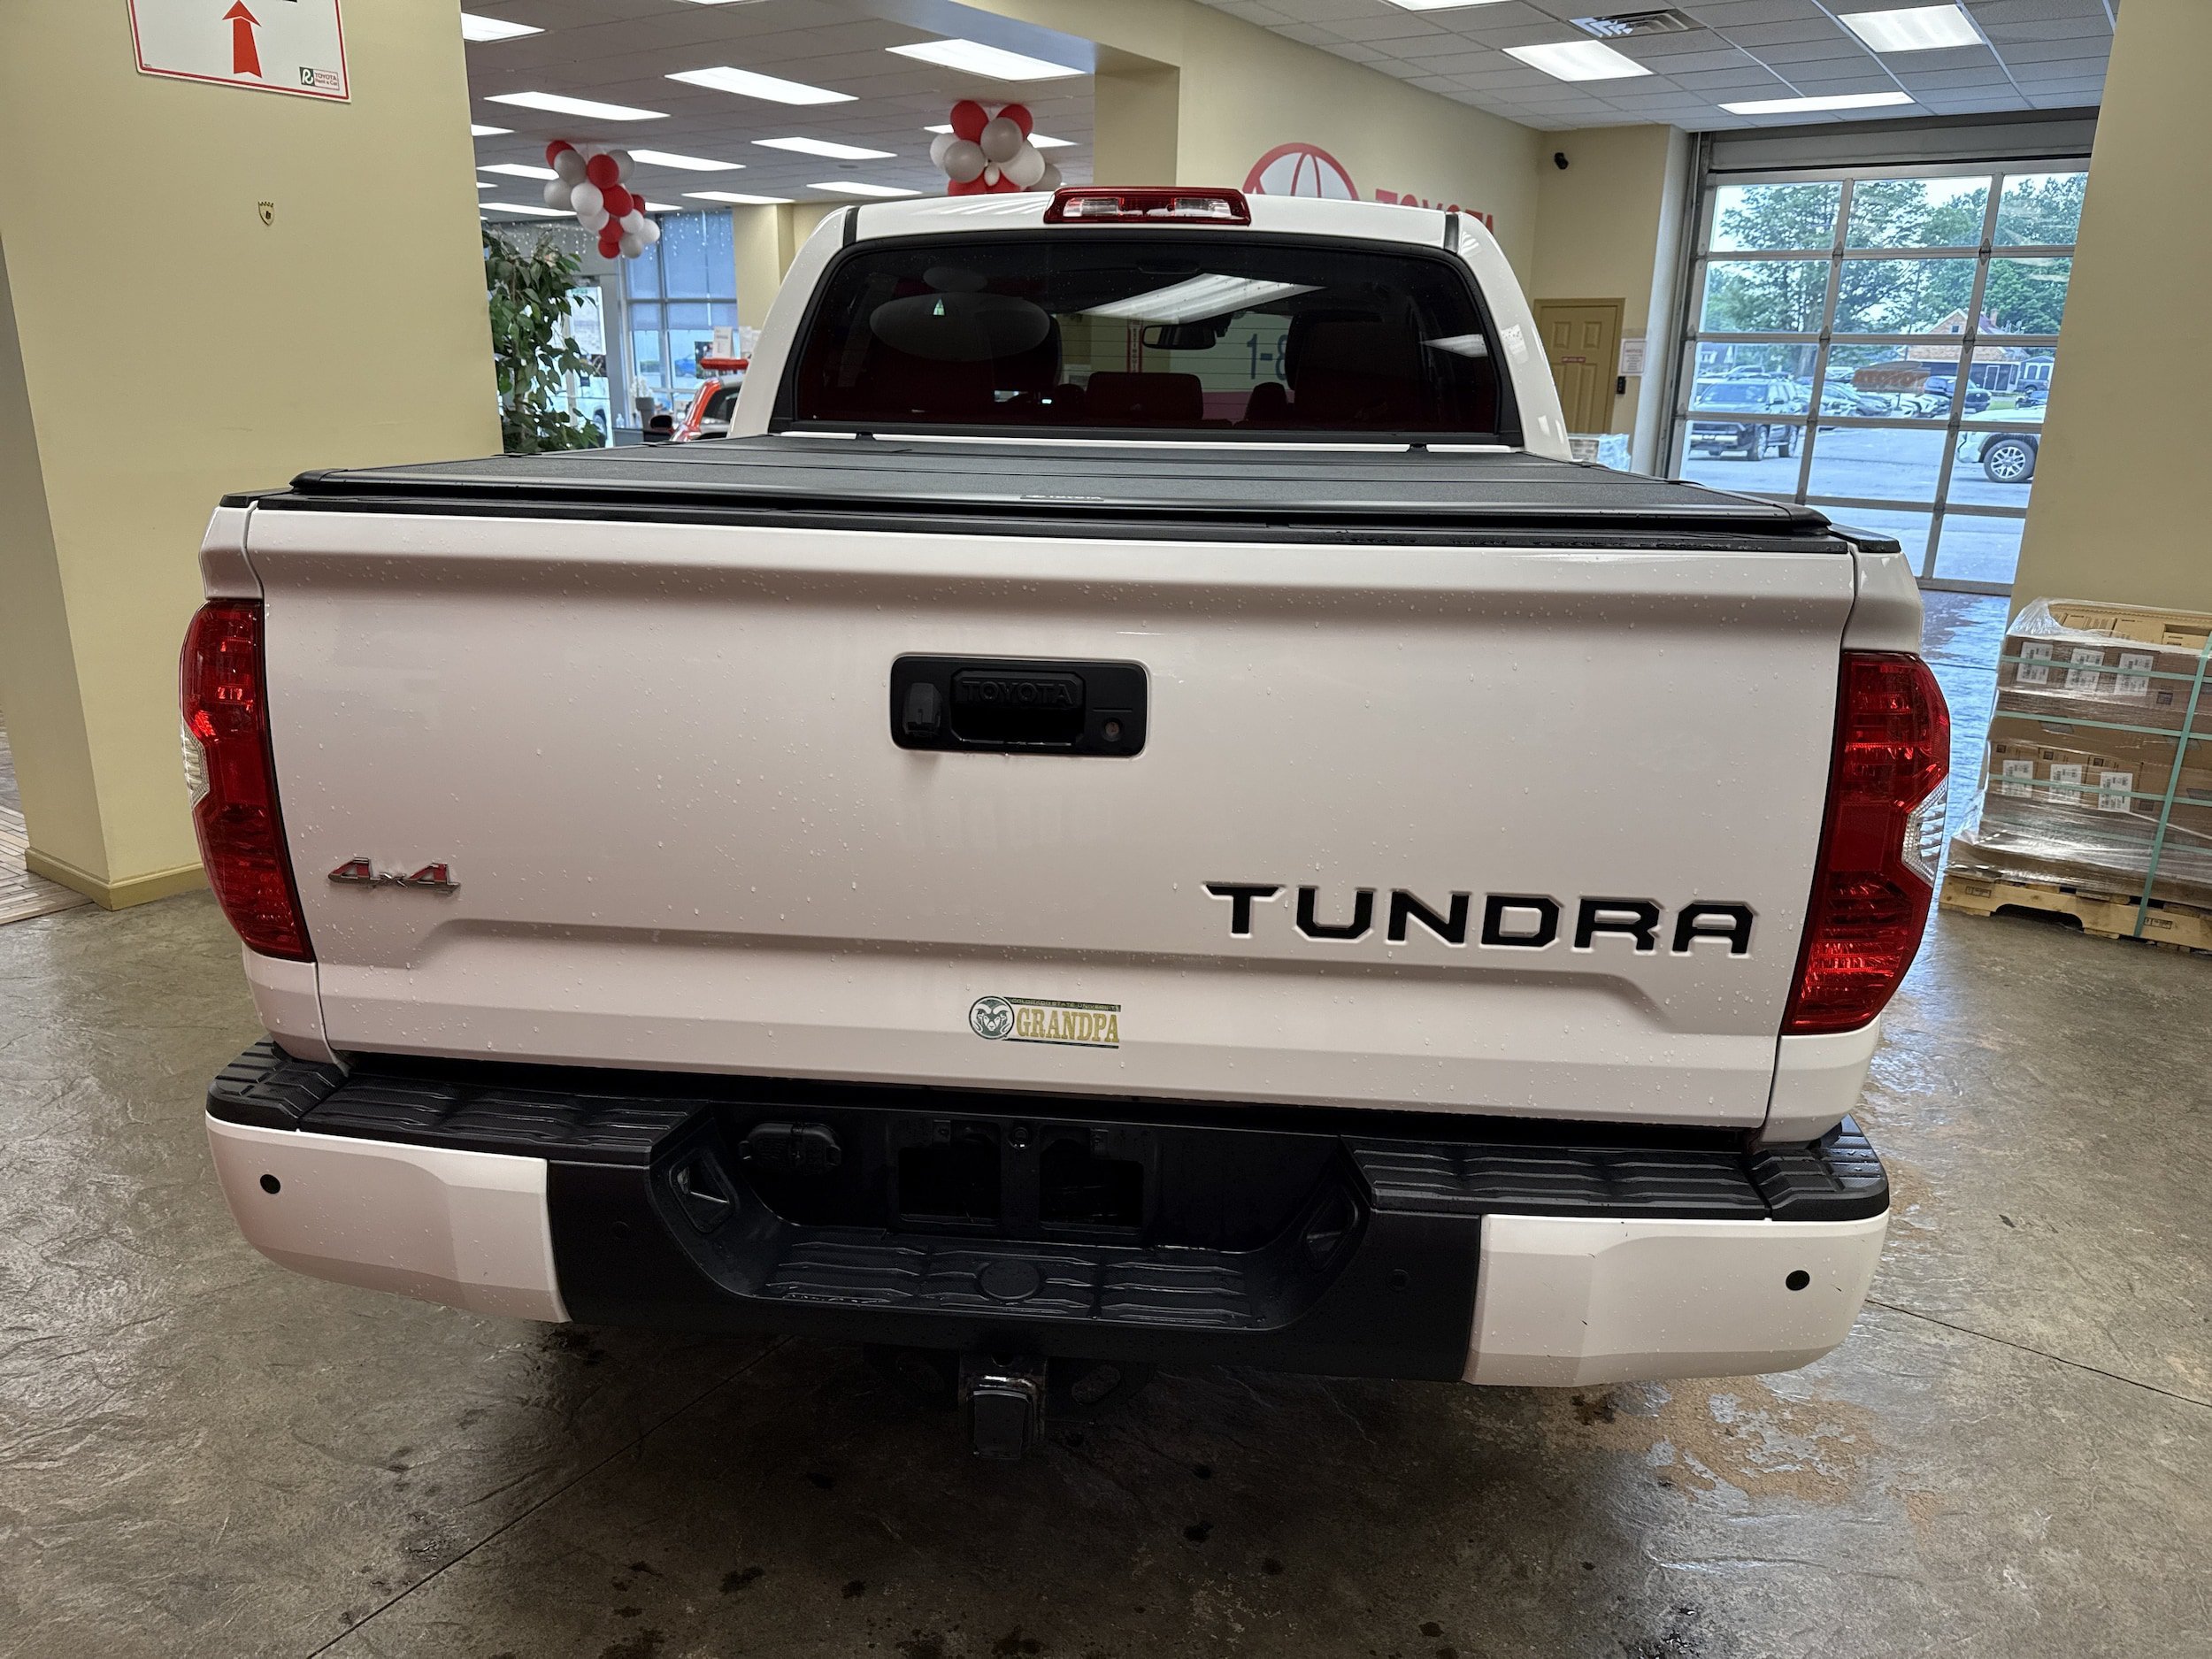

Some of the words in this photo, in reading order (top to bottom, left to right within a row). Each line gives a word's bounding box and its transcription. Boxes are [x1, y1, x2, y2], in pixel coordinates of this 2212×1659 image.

[962, 680, 1074, 705] TOYOTA
[1202, 882, 1758, 957] TUNDRA
[1011, 997, 1050, 1006] COLORADO
[1018, 1008, 1119, 1042] GRANDPA
